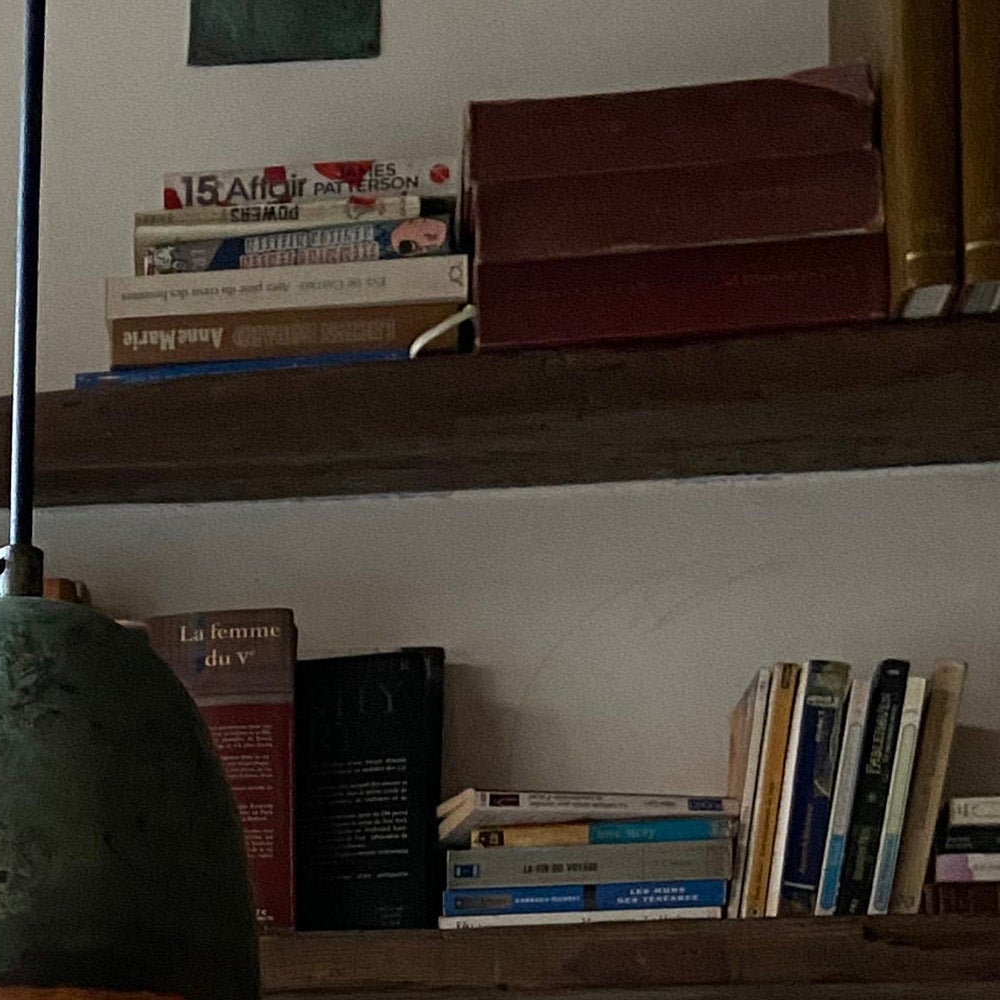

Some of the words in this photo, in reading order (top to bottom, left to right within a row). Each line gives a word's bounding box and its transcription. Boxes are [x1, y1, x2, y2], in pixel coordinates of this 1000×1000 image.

[313, 175, 419, 196] PATTERSON
[230, 205, 300, 222] POWERS
[180, 624, 205, 642] La
[210, 622, 281, 640] femme
[204, 649, 231, 667] du
[566, 861, 598, 873] VOYAGE
